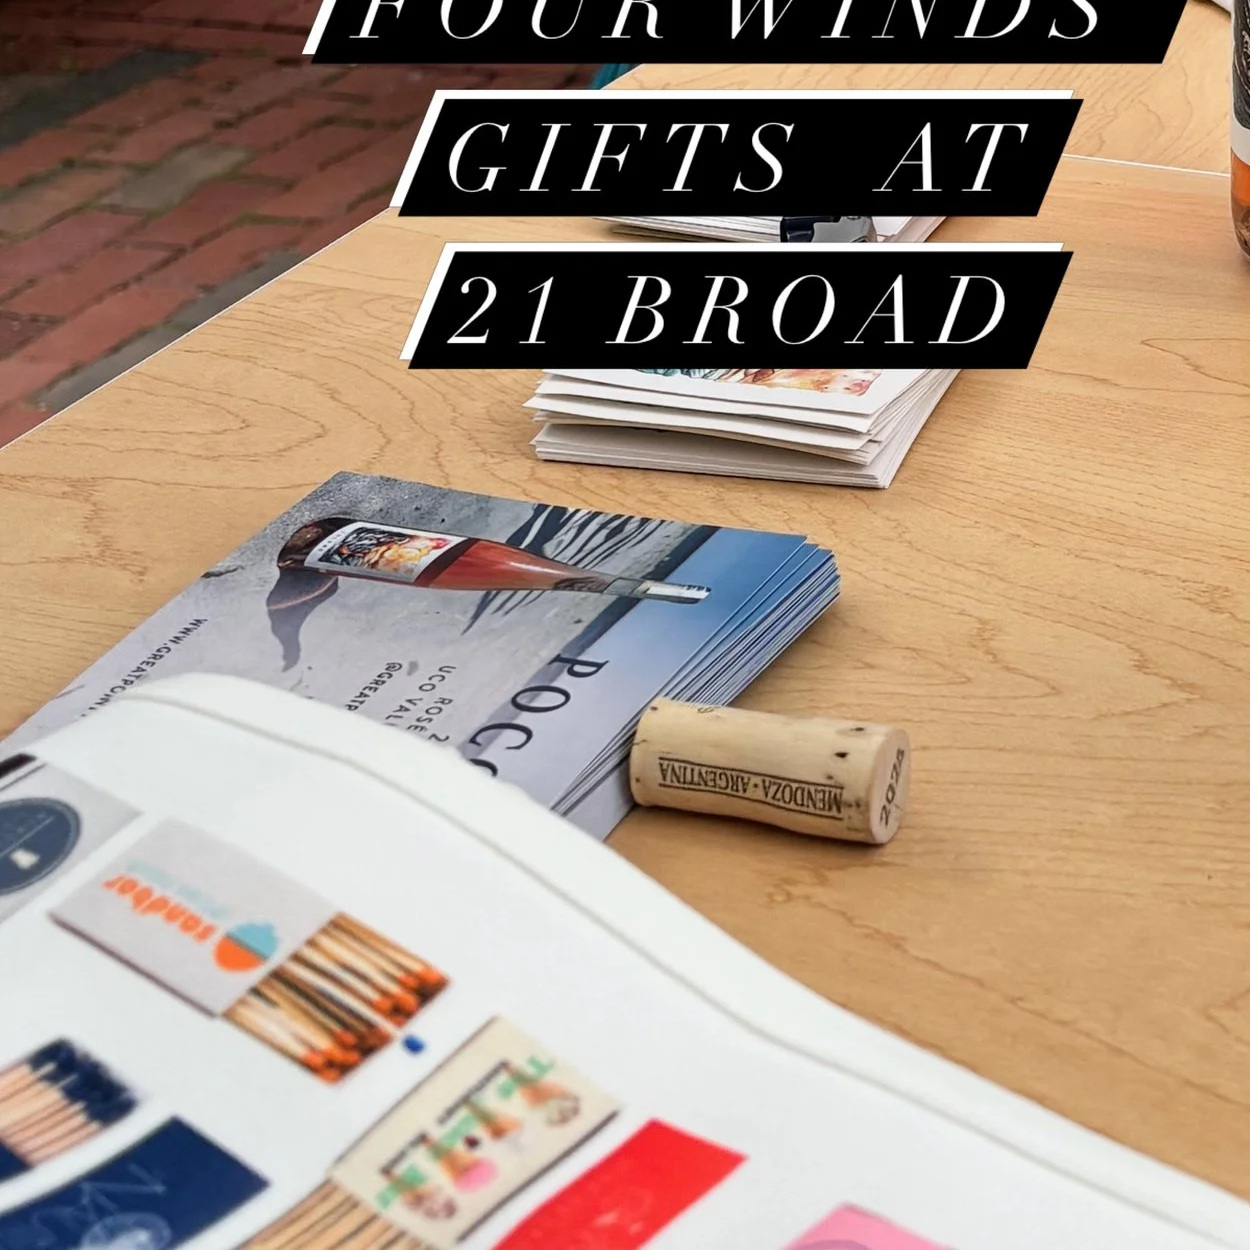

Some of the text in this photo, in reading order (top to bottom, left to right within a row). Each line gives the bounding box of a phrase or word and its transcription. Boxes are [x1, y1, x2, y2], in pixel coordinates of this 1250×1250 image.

[345, 661, 403, 712] @GREATP
[418, 664, 457, 693] UCO
[658, 761, 843, 815] MENDOZA ARGENTINA
